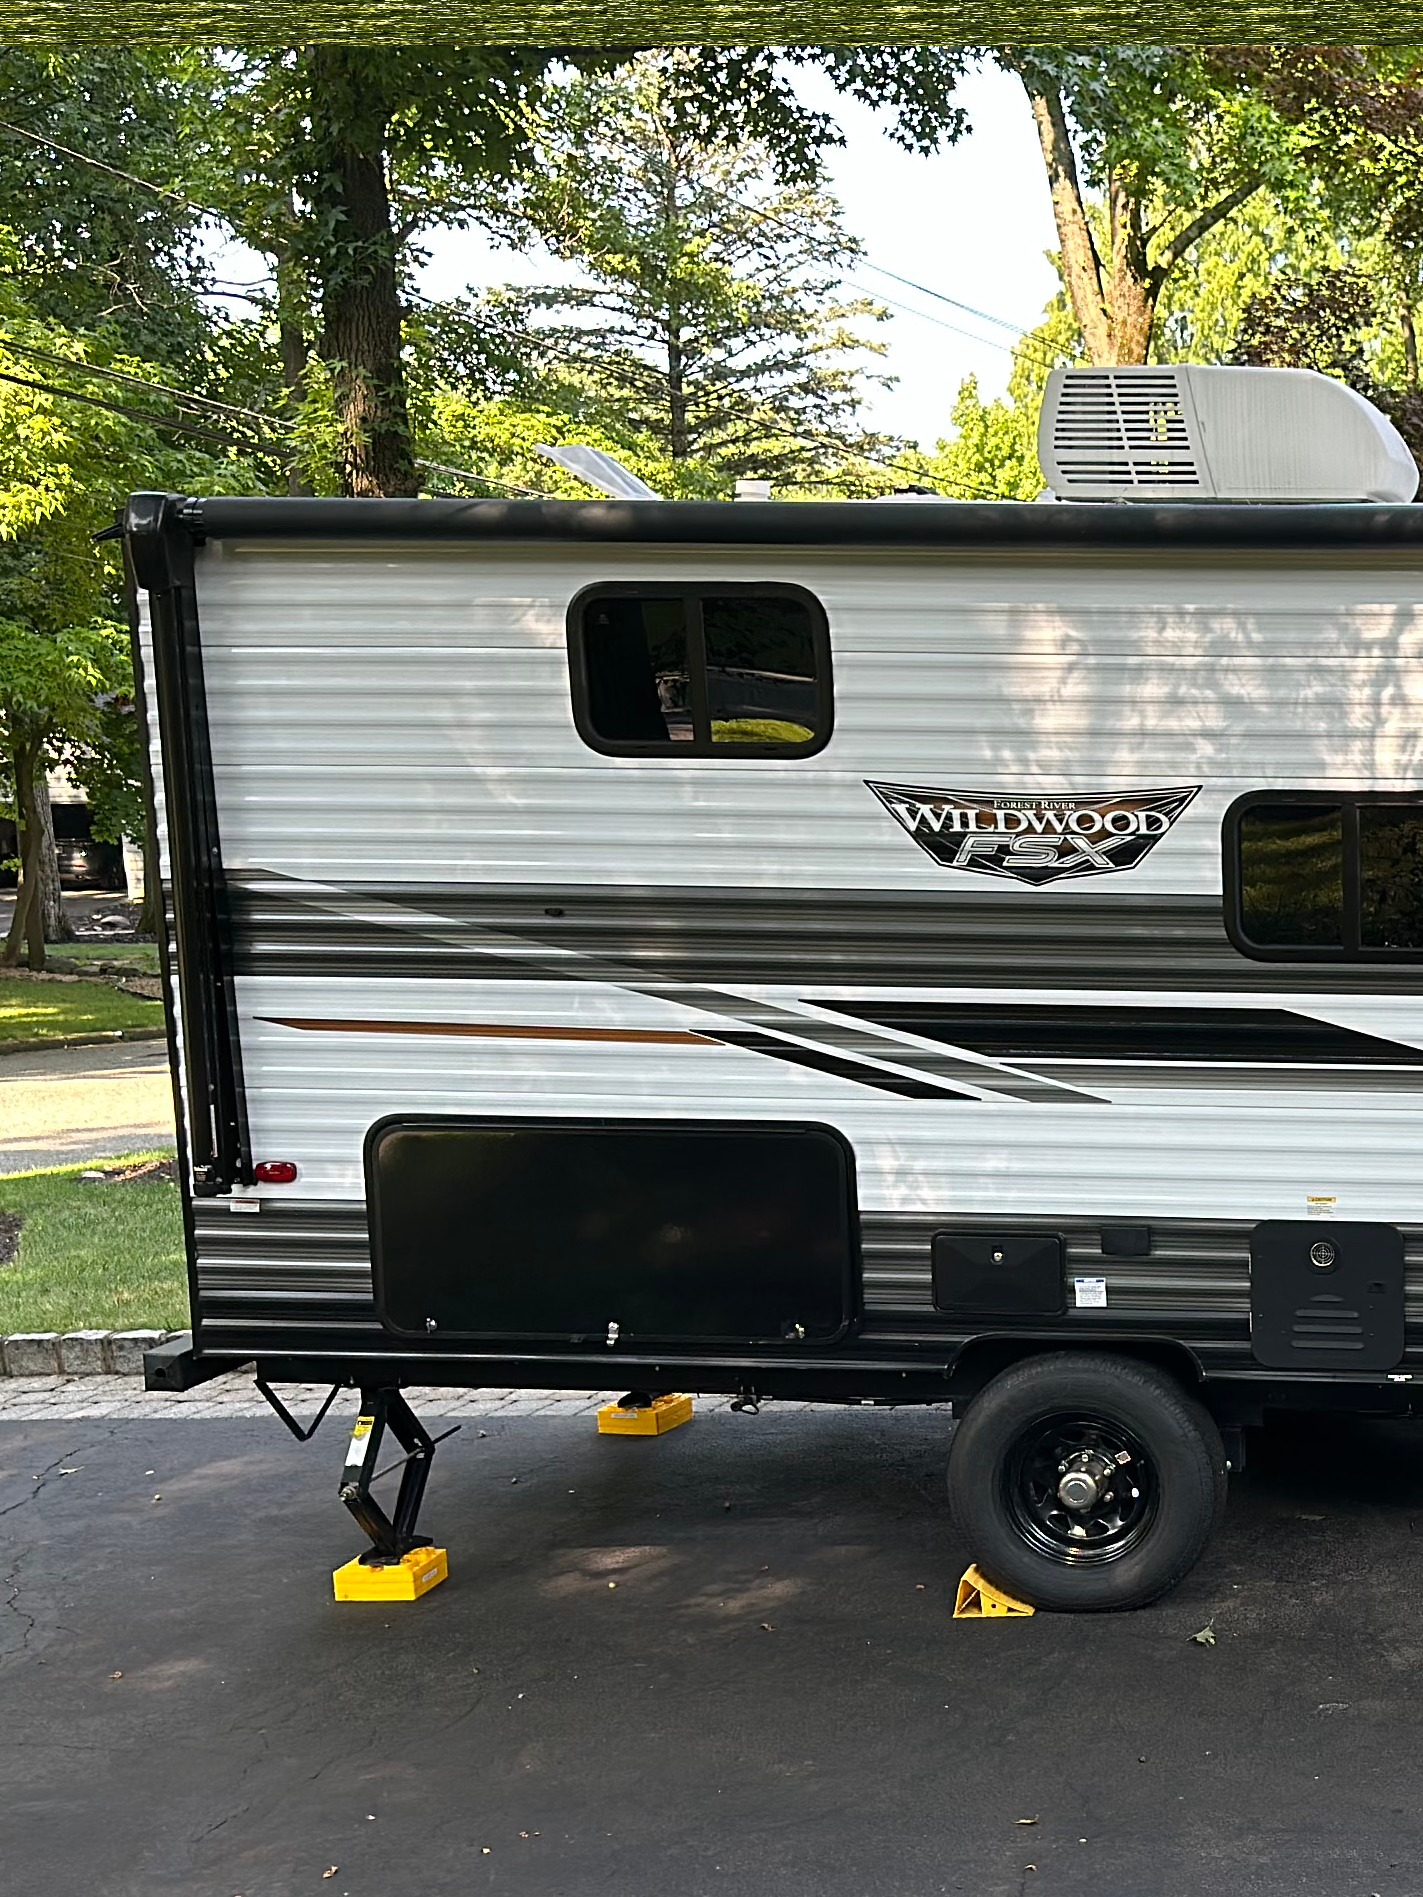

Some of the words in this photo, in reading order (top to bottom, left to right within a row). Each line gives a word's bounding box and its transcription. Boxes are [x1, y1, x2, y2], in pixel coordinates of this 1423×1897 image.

[891, 803, 1170, 835] WILDWOOD
[993, 800, 1038, 809] FOREST
[1041, 801, 1076, 810] RIVER
[952, 834, 1137, 868] FSX
